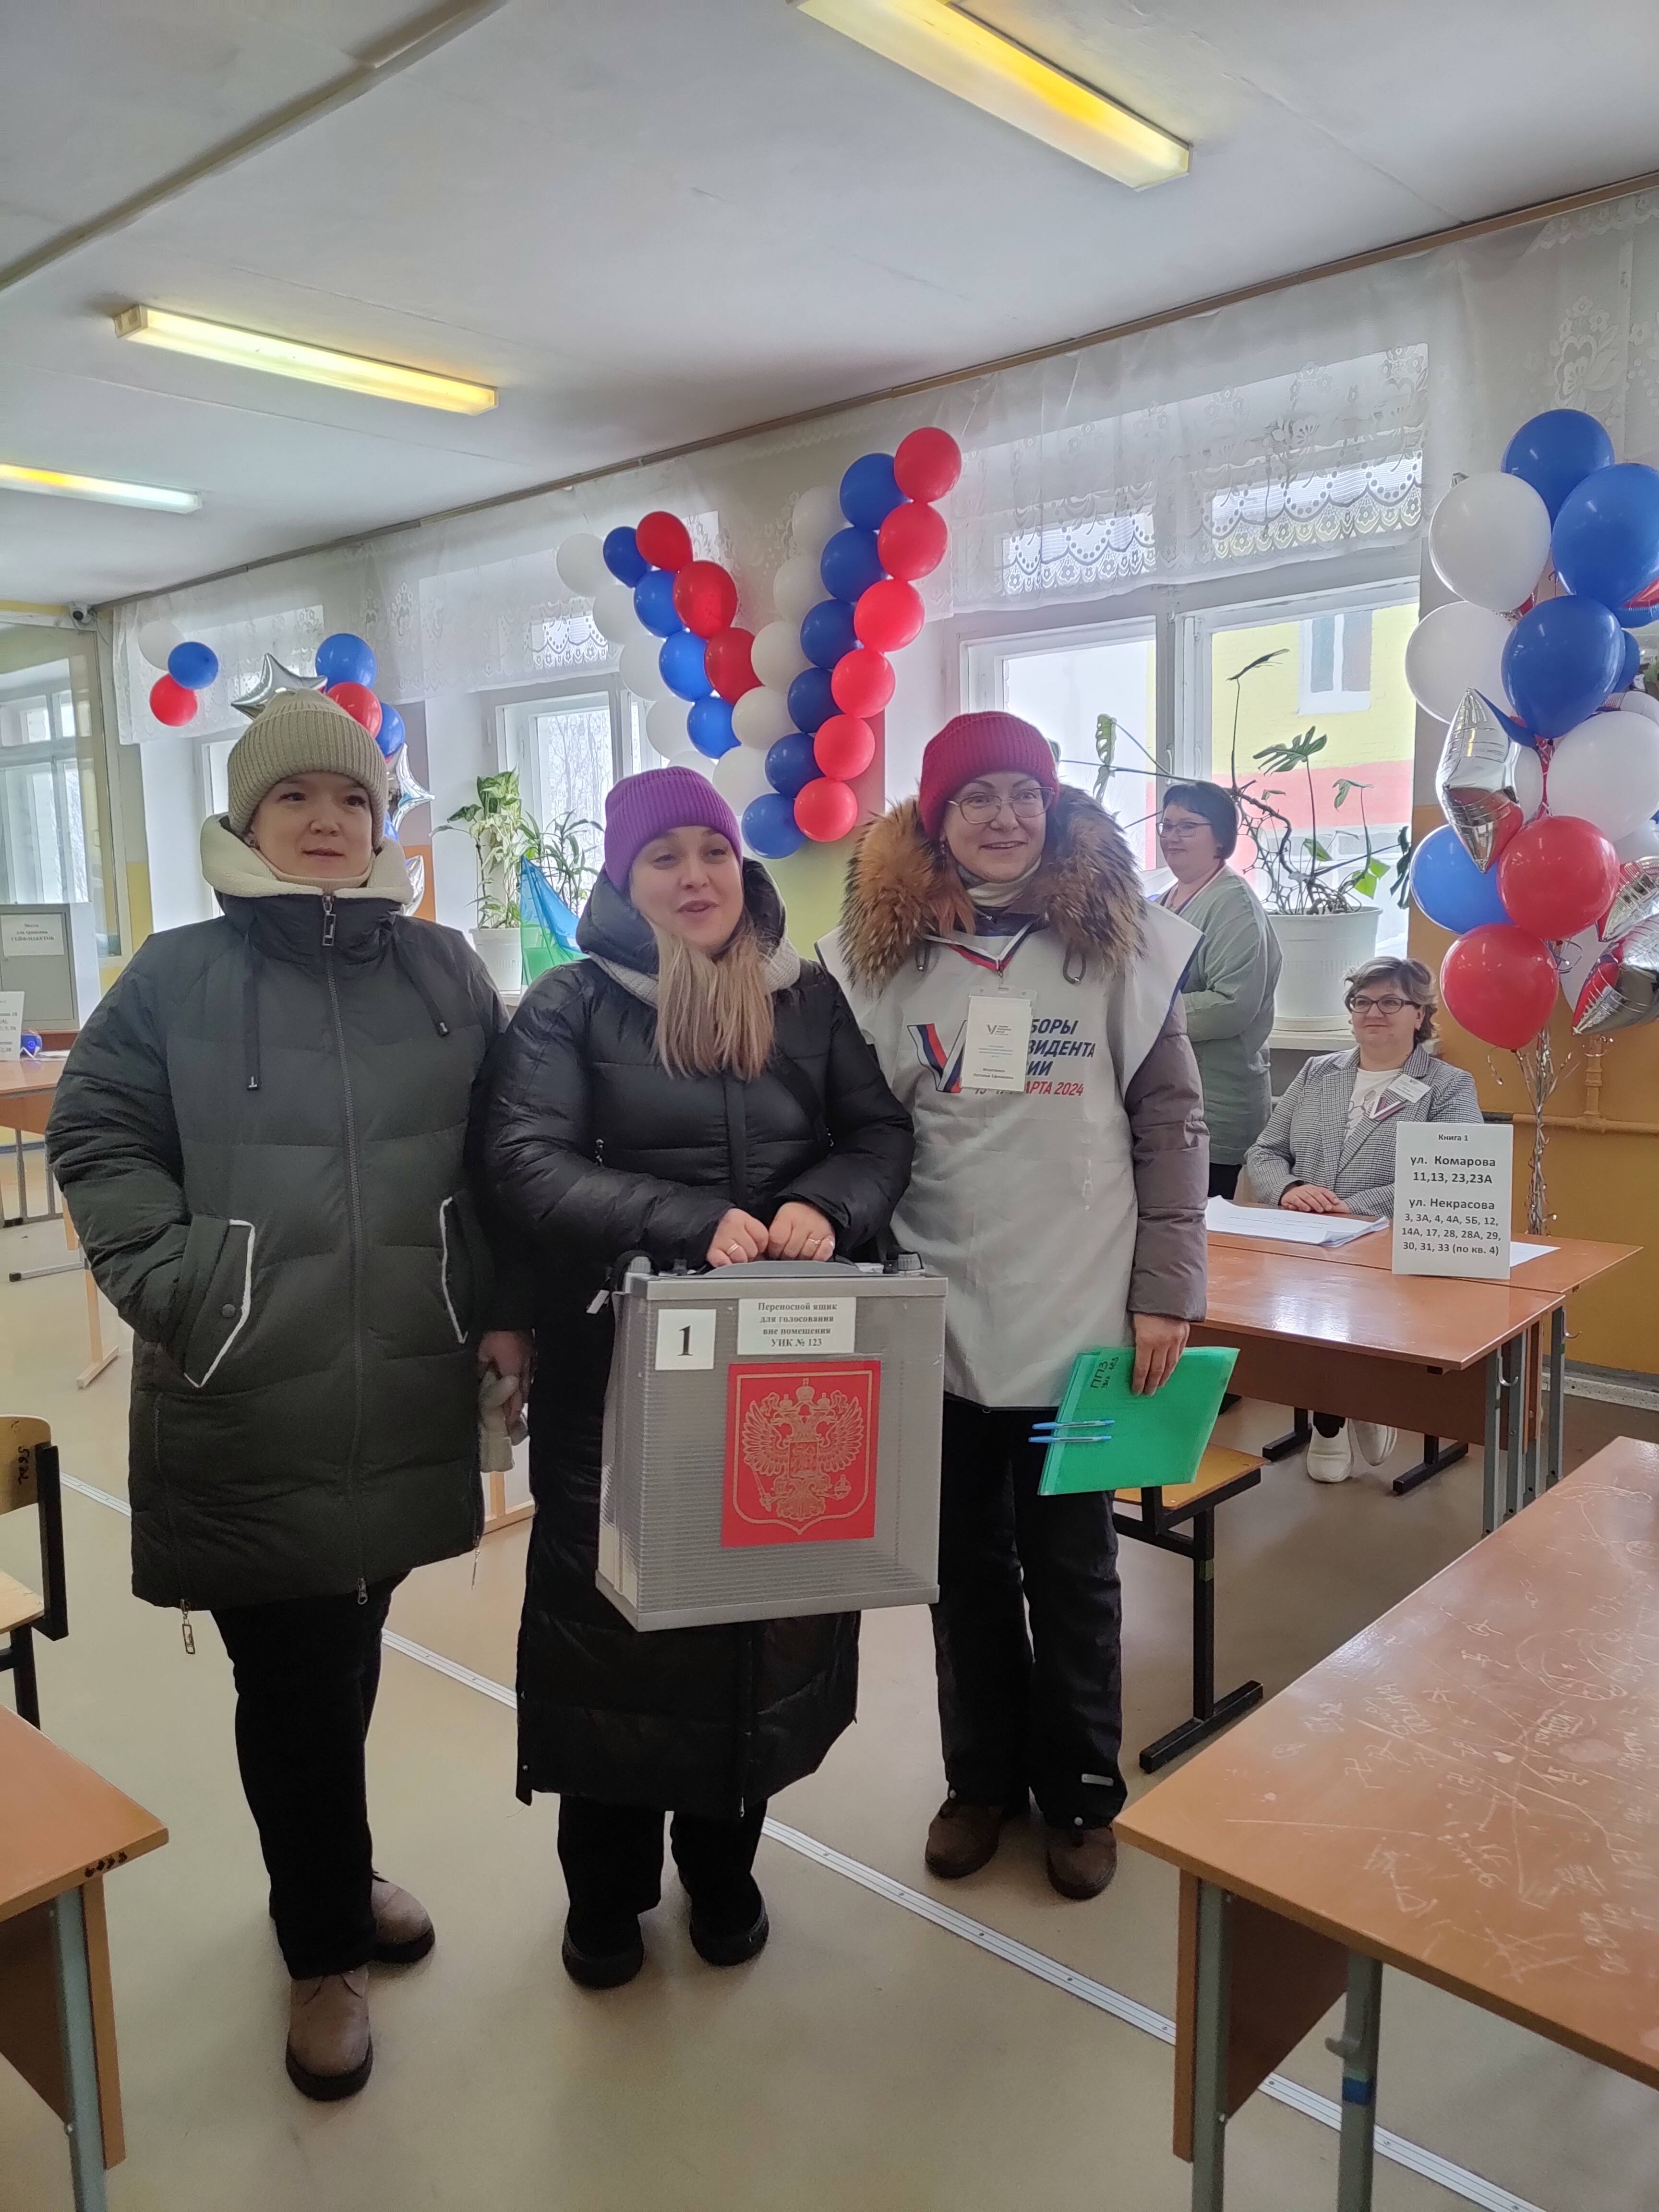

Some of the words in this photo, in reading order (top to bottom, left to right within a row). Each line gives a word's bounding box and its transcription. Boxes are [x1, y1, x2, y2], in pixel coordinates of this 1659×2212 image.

[1032, 1019, 1079, 1034] БОРЫ
[1028, 1040, 1096, 1058] ЗИДЕНТА
[1024, 1081, 1053, 1094] АРТА
[1054, 1082, 1084, 1096] 2024
[1410, 1156, 1428, 1166] ул.
[1434, 1155, 1496, 1167] Комарова
[1413, 1172, 1448, 1184] 11,13,
[1451, 1173, 1492, 1184] 23,23А
[1409, 1199, 1426, 1208] ул.
[1430, 1198, 1495, 1210] Некрасова
[1405, 1214, 1413, 1222] 3,
[1416, 1214, 1432, 1223] 3А,
[1434, 1215, 1443, 1224] 4,
[1446, 1215, 1462, 1225] 4А,
[1465, 1216, 1480, 1226] 5Б,
[1484, 1217, 1499, 1226] 12,
[1402, 1227, 1423, 1237] 14А,
[1426, 1228, 1441, 1238] 17,
[1443, 1229, 1458, 1239] 28,
[1461, 1230, 1483, 1240] 28А,
[1486, 1231, 1501, 1241] 29,
[1403, 1242, 1417, 1251] 30,
[1420, 1243, 1435, 1252] 31,
[1438, 1243, 1449, 1251] 33
[1453, 1244, 1468, 1254] (по
[1489, 1246, 1499, 1256] 4)
[758, 1302, 811, 1312] Переносной
[677, 1325, 693, 1356] 1
[771, 1338, 793, 1347] УИК
[795, 1338, 805, 1346] №
[808, 1338, 822, 1346] 123
